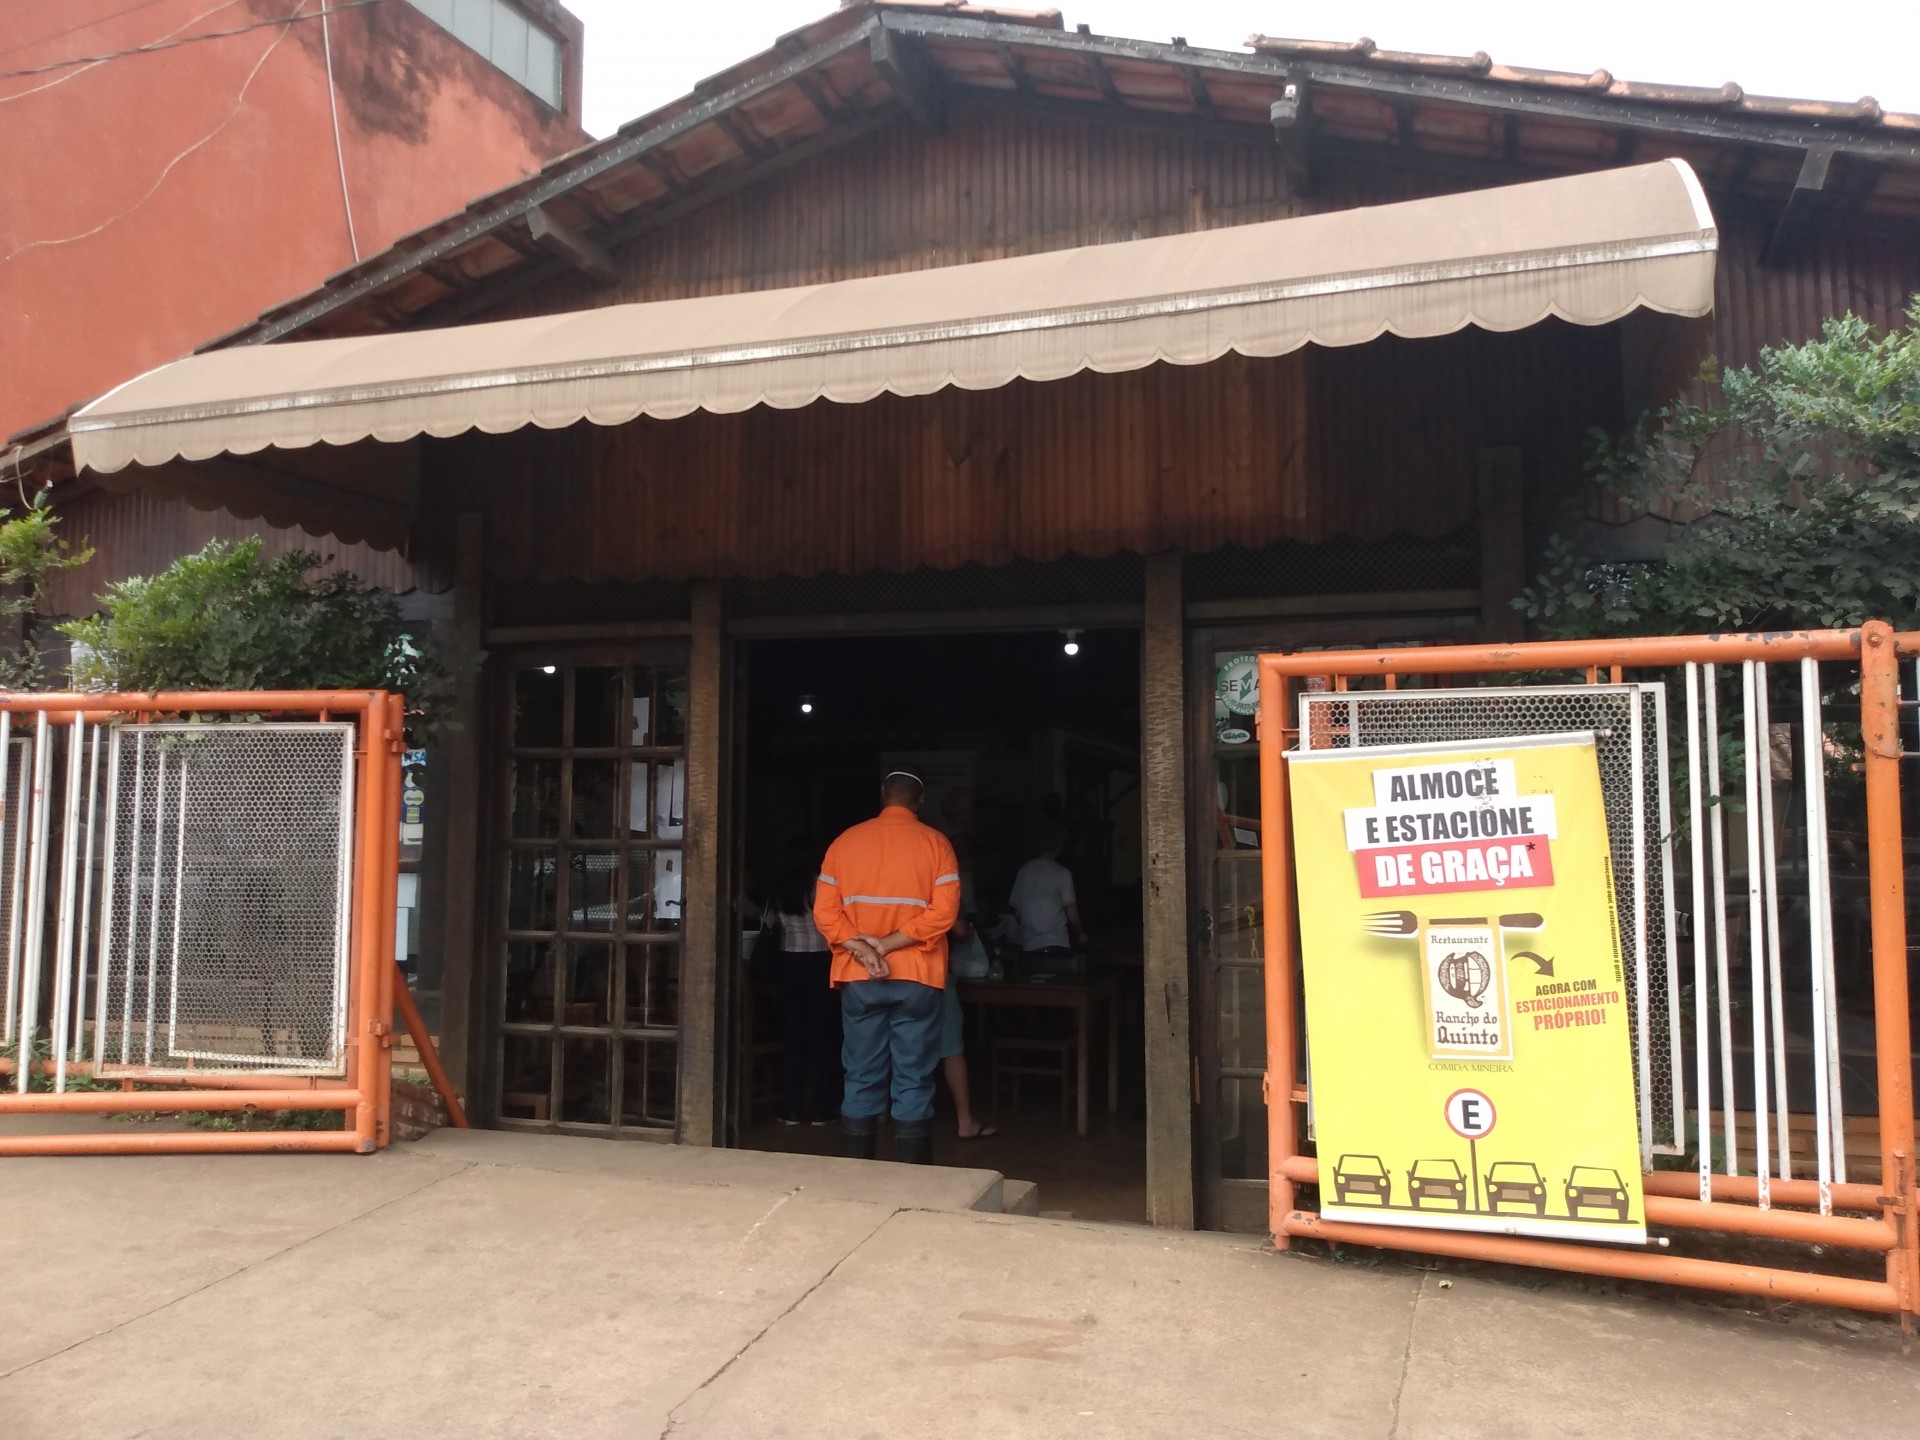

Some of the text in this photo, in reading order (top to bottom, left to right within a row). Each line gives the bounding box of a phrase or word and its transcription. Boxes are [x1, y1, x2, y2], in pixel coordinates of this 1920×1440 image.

[1391, 768, 1499, 802] ALMOCE
[1365, 806, 1535, 844] E ESTACIONE
[1375, 853, 1416, 888] DE
[1431, 935, 1489, 944] Restaurante
[1535, 979, 1597, 996] AGORA COM
[1516, 991, 1619, 1013] ESTACIONAMENTO
[1436, 1011, 1498, 1026] Rancho do
[1533, 1008, 1606, 1031] PRÓPRIO!
[1437, 1025, 1499, 1045] Quinto
[1428, 1063, 1514, 1073] COMIDA MINEIRA
[1461, 1100, 1482, 1130] E
